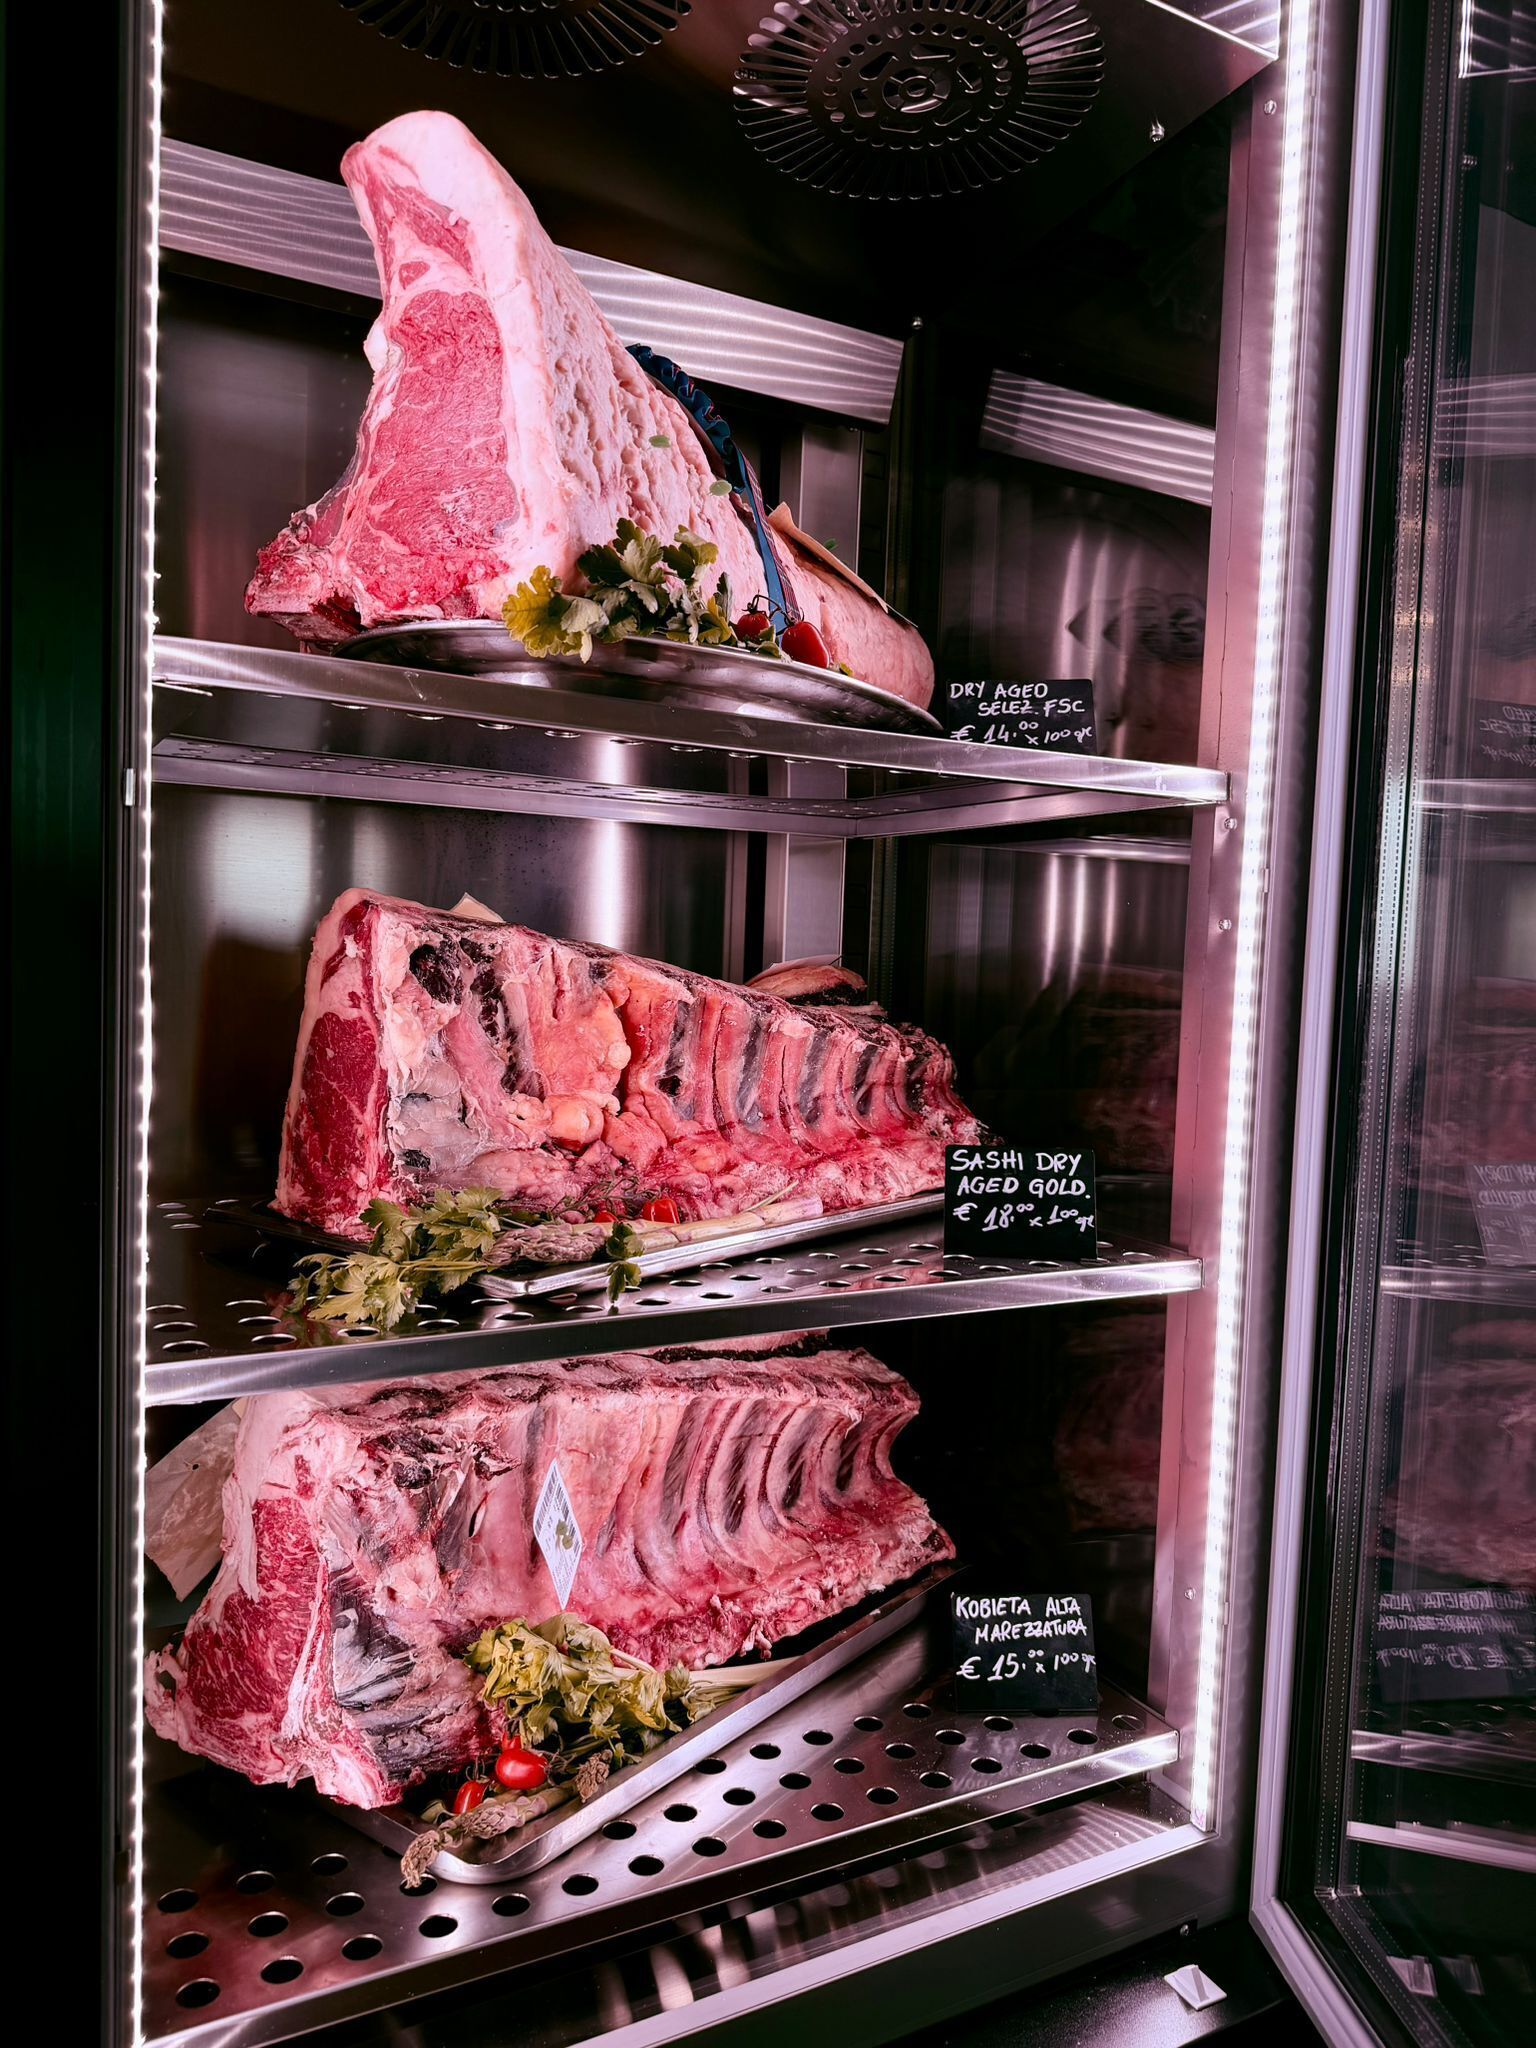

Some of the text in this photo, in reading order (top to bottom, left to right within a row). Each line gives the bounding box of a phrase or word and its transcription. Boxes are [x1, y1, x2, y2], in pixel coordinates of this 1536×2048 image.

[950, 681, 1048, 700] DRY AGED
[1043, 698, 1085, 717] FSC
[949, 724, 976, 742] €
[950, 1149, 1082, 1176] SASHI DRY
[956, 1175, 1019, 1196] AGED
[952, 1202, 978, 1221] €
[955, 1596, 1081, 1619] KOBIETA ALTA
[956, 1656, 981, 1680] €
